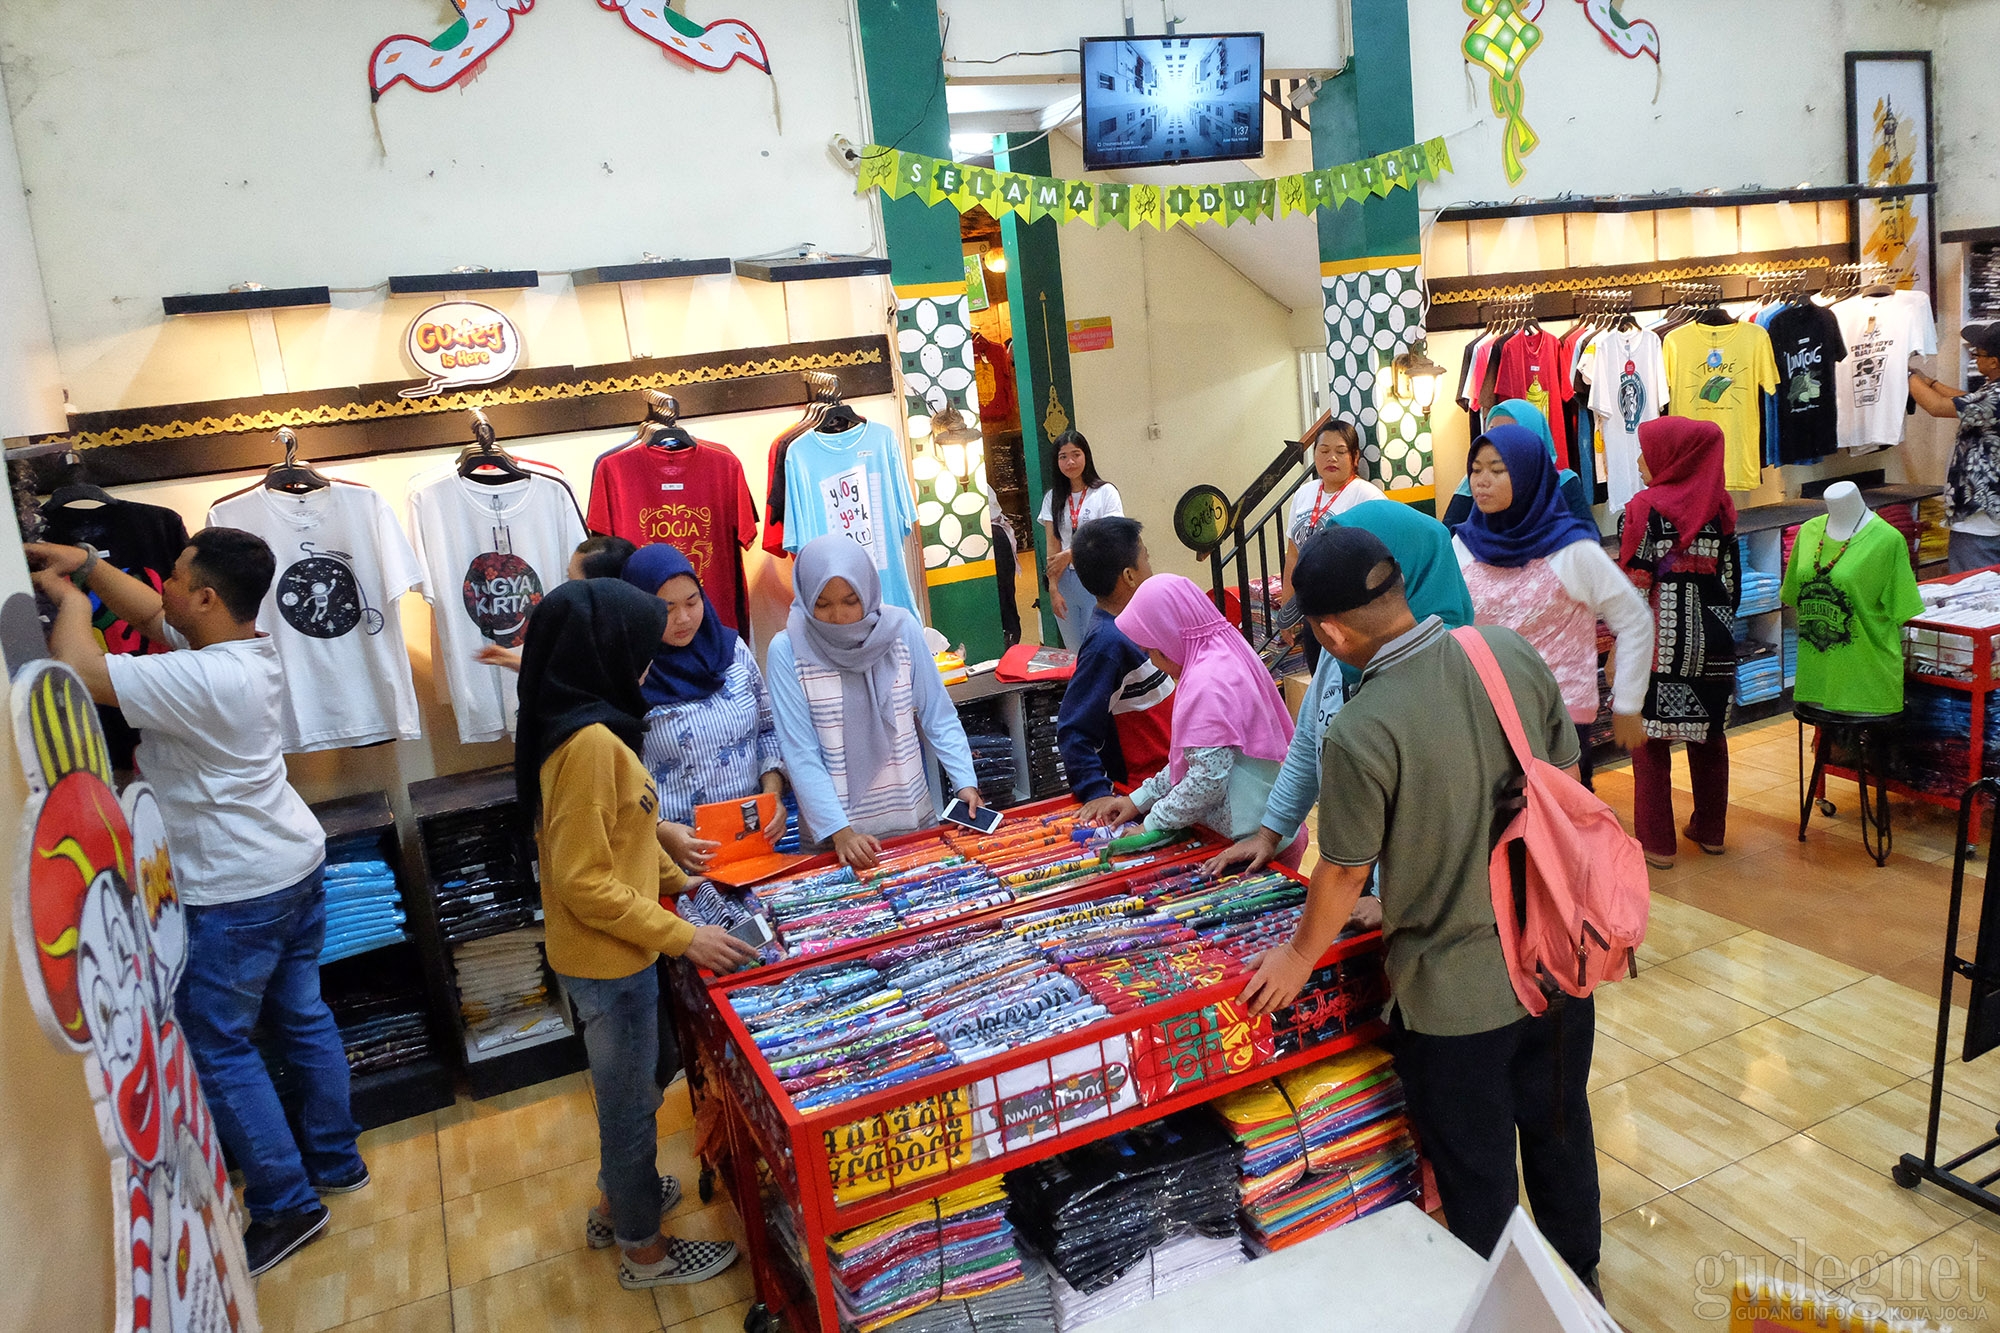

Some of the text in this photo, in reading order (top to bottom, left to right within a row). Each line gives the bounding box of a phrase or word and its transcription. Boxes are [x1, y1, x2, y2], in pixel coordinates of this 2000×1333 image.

[910, 153, 1419, 211] SELAMAT IDUL FITRI
[456, 350, 490, 367] Here
[649, 520, 700, 538] JOGJA
